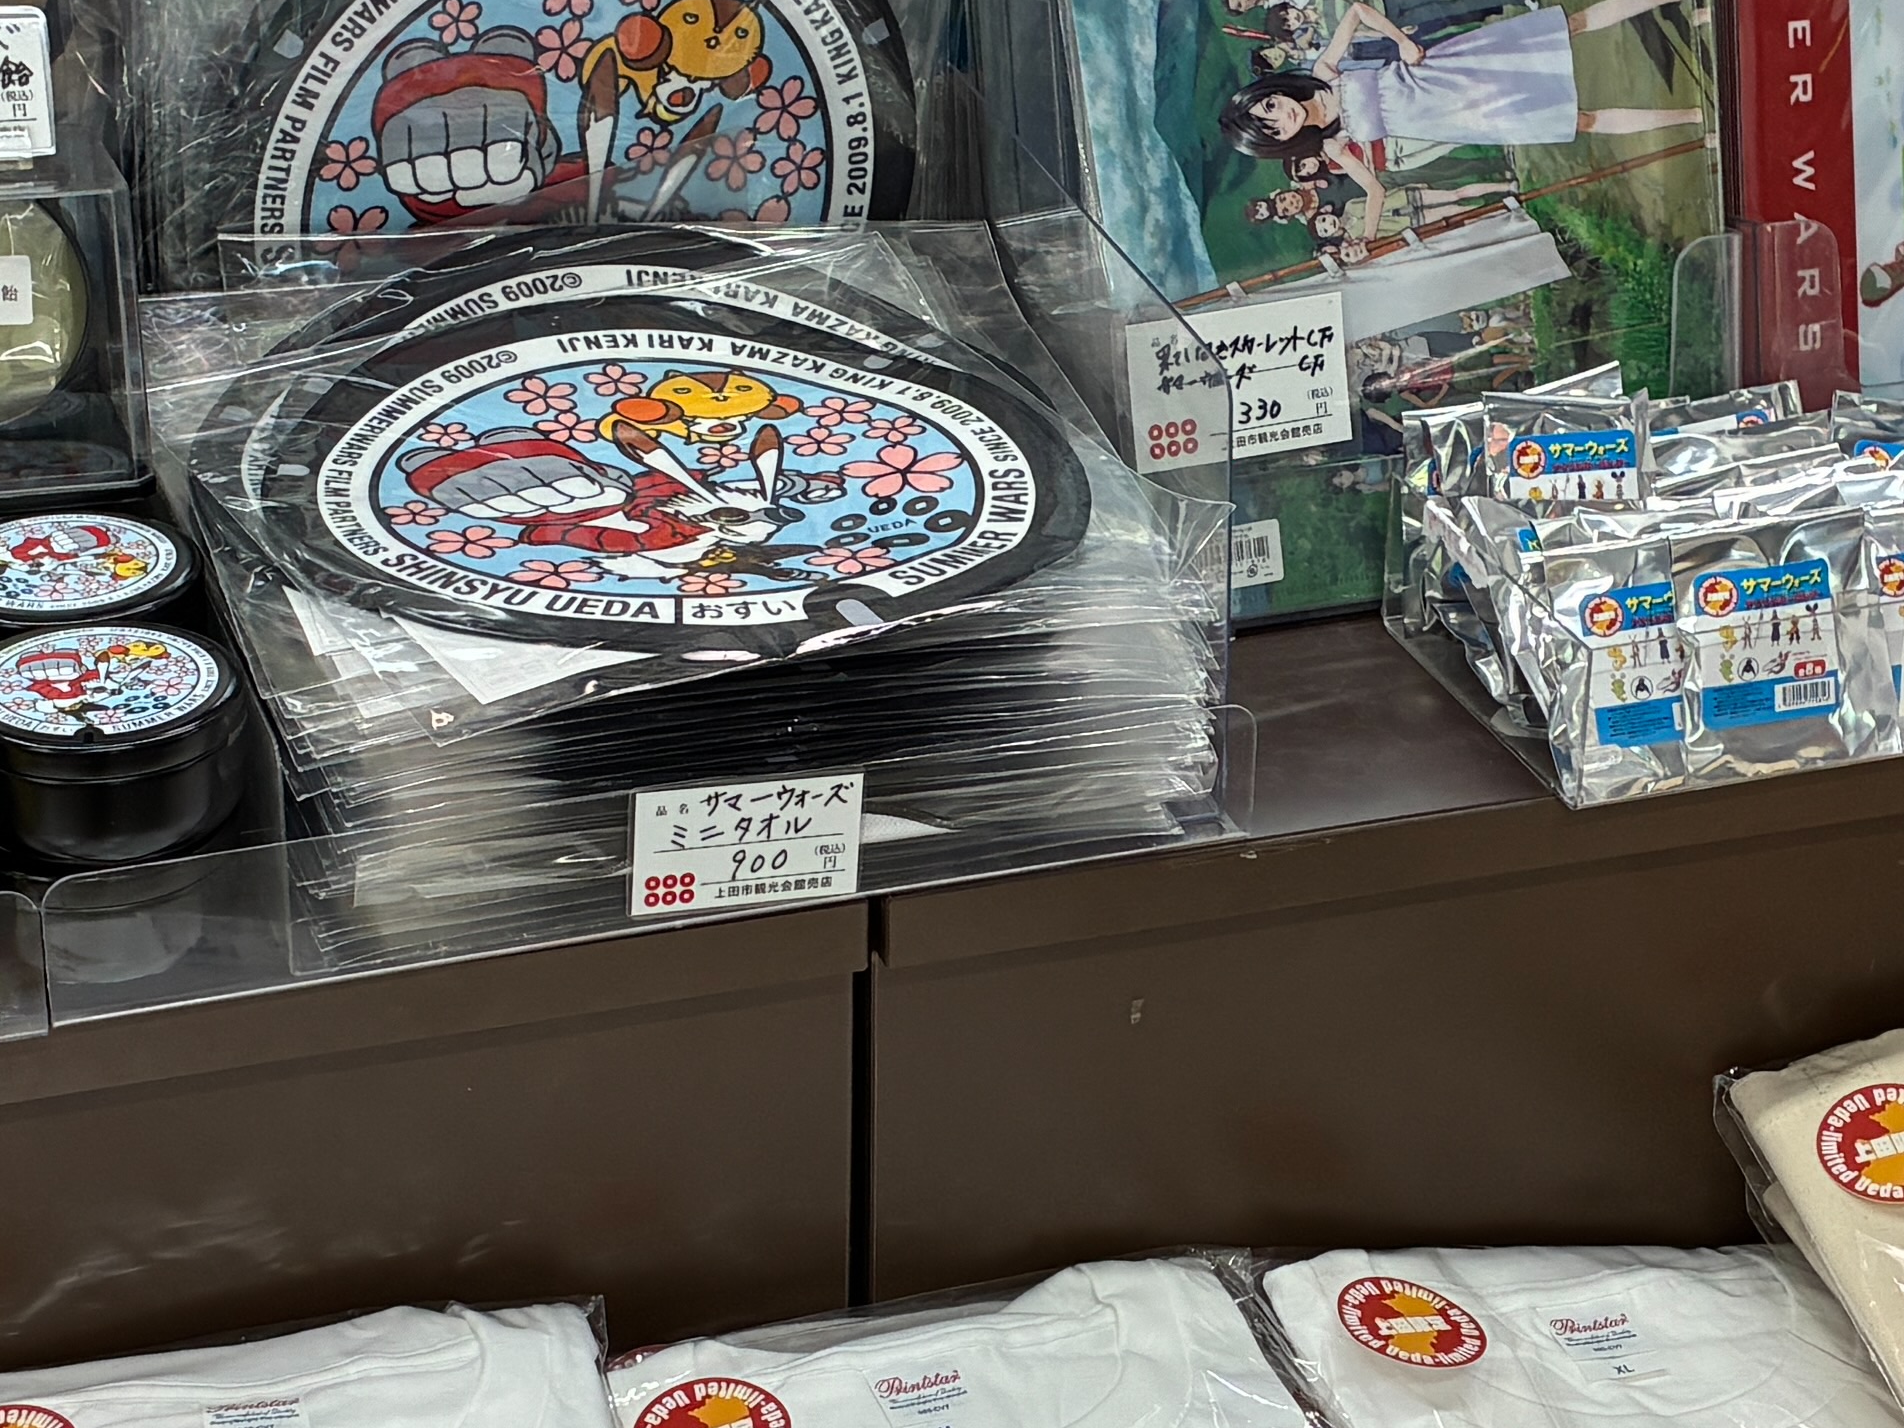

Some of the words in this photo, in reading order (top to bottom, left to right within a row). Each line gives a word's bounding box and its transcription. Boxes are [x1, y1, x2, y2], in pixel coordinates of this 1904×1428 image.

[297, 52, 341, 99] FILM
[259, 101, 308, 235] PARTNERS
[1790, 150, 1822, 355] WARS
[556, 332, 638, 353] KENJI
[648, 333, 715, 352] KARI
[731, 341, 820, 369] KAZMA
[444, 350, 518, 384] ©2009
[829, 367, 886, 391] KING
[333, 379, 444, 465] SUMMERWARS
[1238, 399, 1282, 424] 330
[1546, 430, 1634, 464] サマーウォーズ
[325, 469, 352, 499] FILM
[998, 470, 1030, 533] WARS
[325, 500, 386, 557] PARTNERS
[867, 517, 917, 533] UEDA
[900, 529, 1012, 585] SUMMER
[382, 552, 541, 616] SHINSYU
[544, 594, 660, 620] UEDA
[690, 597, 799, 620] おすい
[1740, 568, 1822, 595] サマーウォーズ
[656, 804, 689, 816] 品名
[700, 782, 854, 816] サマーウォーズ
[671, 813, 812, 849] ミニタオル
[732, 849, 788, 881] 900
[824, 856, 836, 869] 円
[715, 876, 832, 899] 上田市観光会館売店
[1550, 1313, 1629, 1336] Printstar
[874, 1370, 961, 1399] Printstar
[1614, 1364, 1635, 1375] XL
